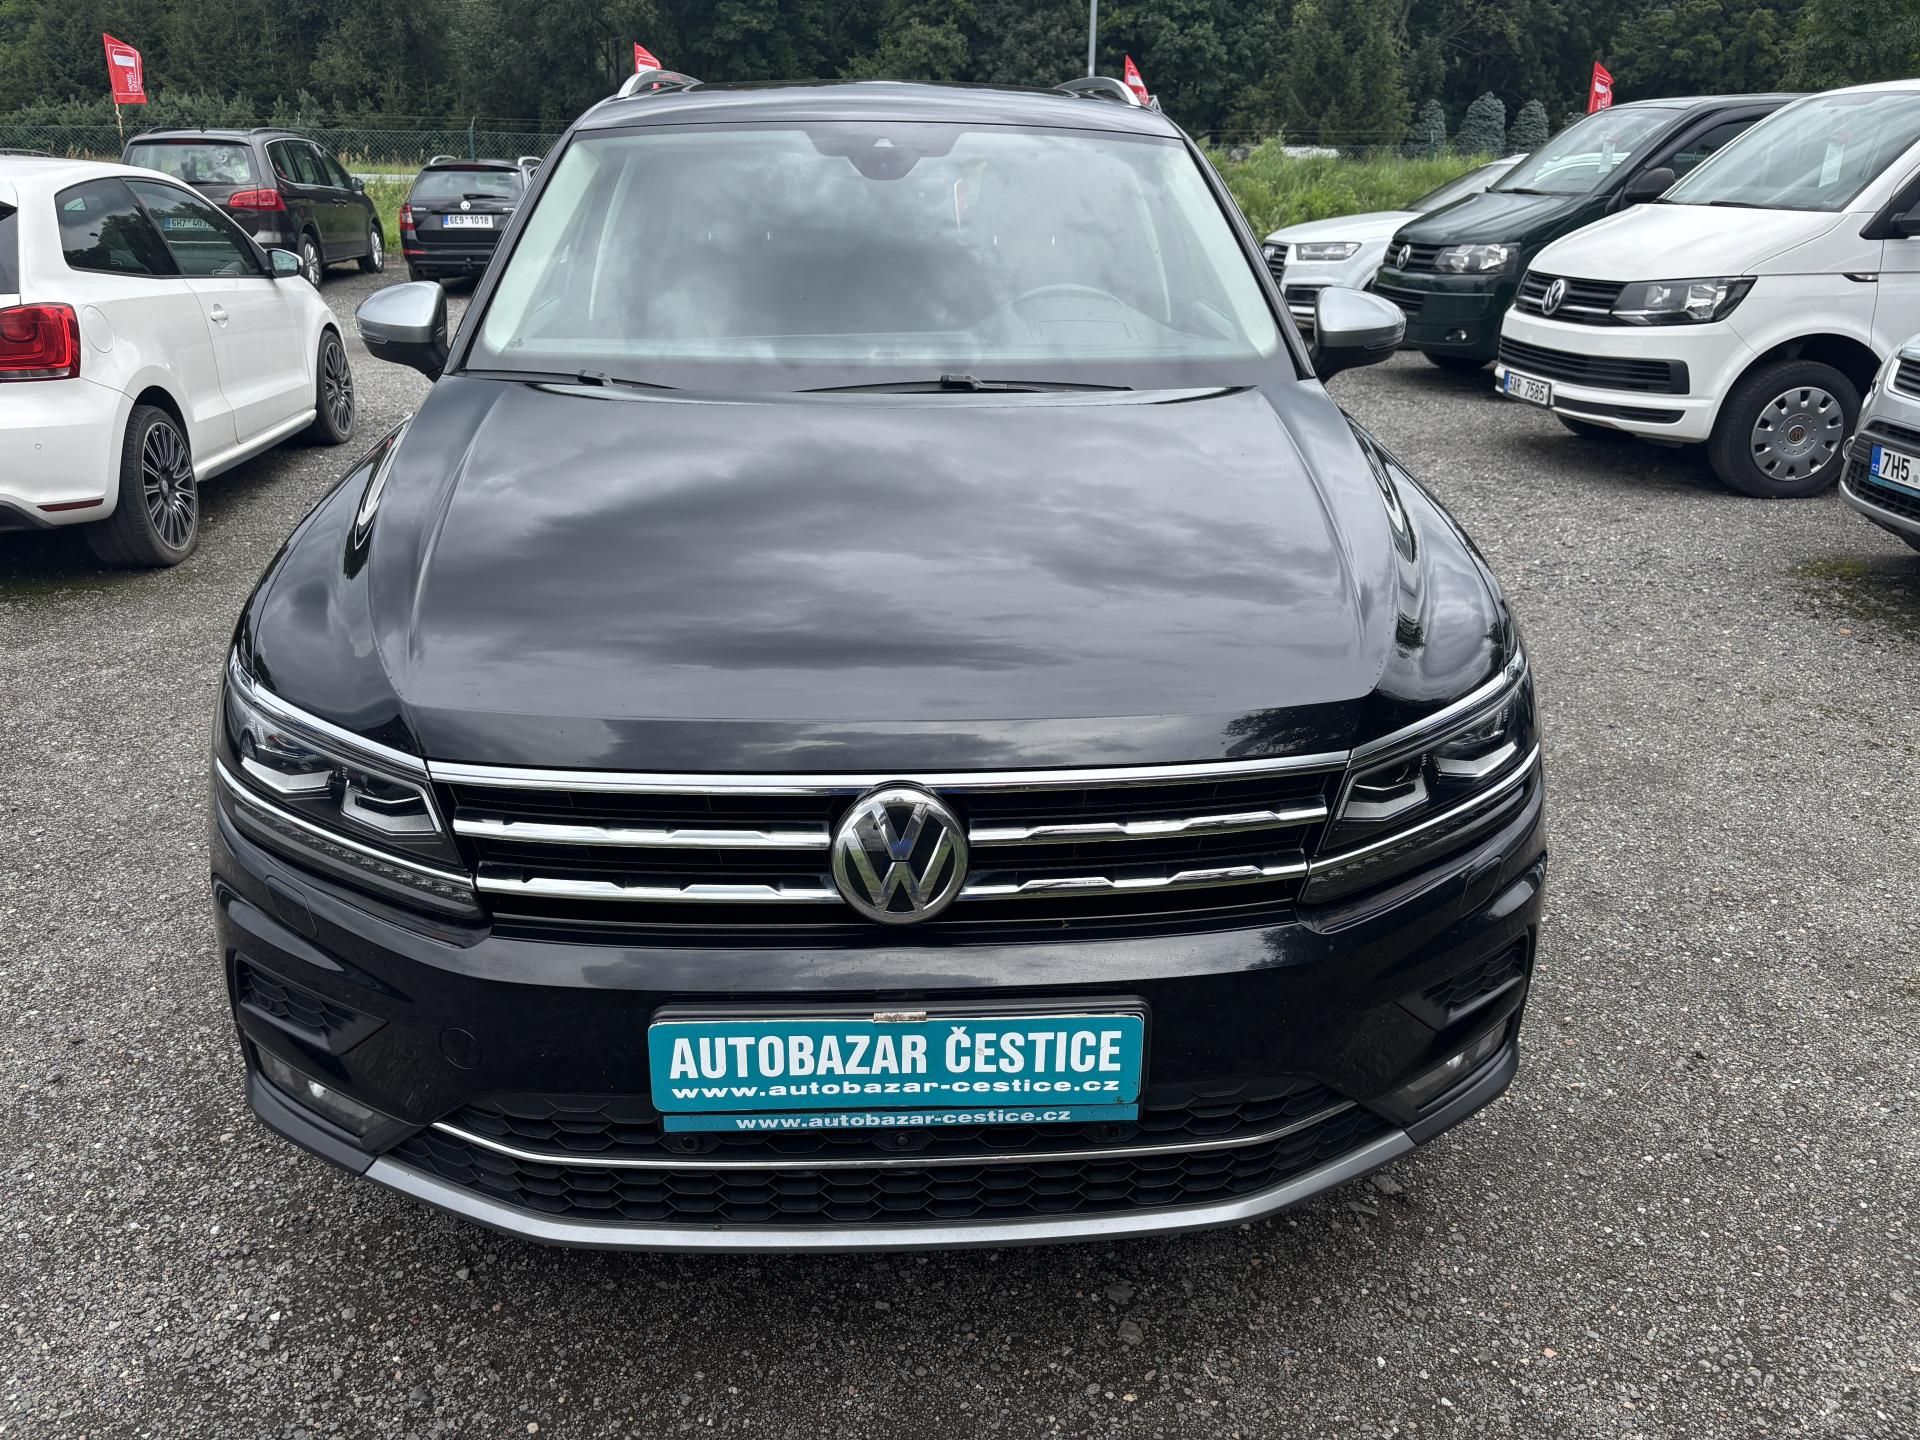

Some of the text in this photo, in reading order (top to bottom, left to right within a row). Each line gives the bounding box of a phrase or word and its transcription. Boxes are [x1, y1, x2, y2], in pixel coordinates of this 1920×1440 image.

[450, 216, 489, 225] 6E9 1018
[1525, 381, 1545, 401] 7585
[1882, 451, 1911, 481] 7H5
[669, 1026, 1122, 1079] AUTOBAZAR ČESTICE
[672, 1079, 1120, 1099] www.autobazar-cestice.cz
[735, 1109, 1071, 1129] www.autobazar-cestice.cz
